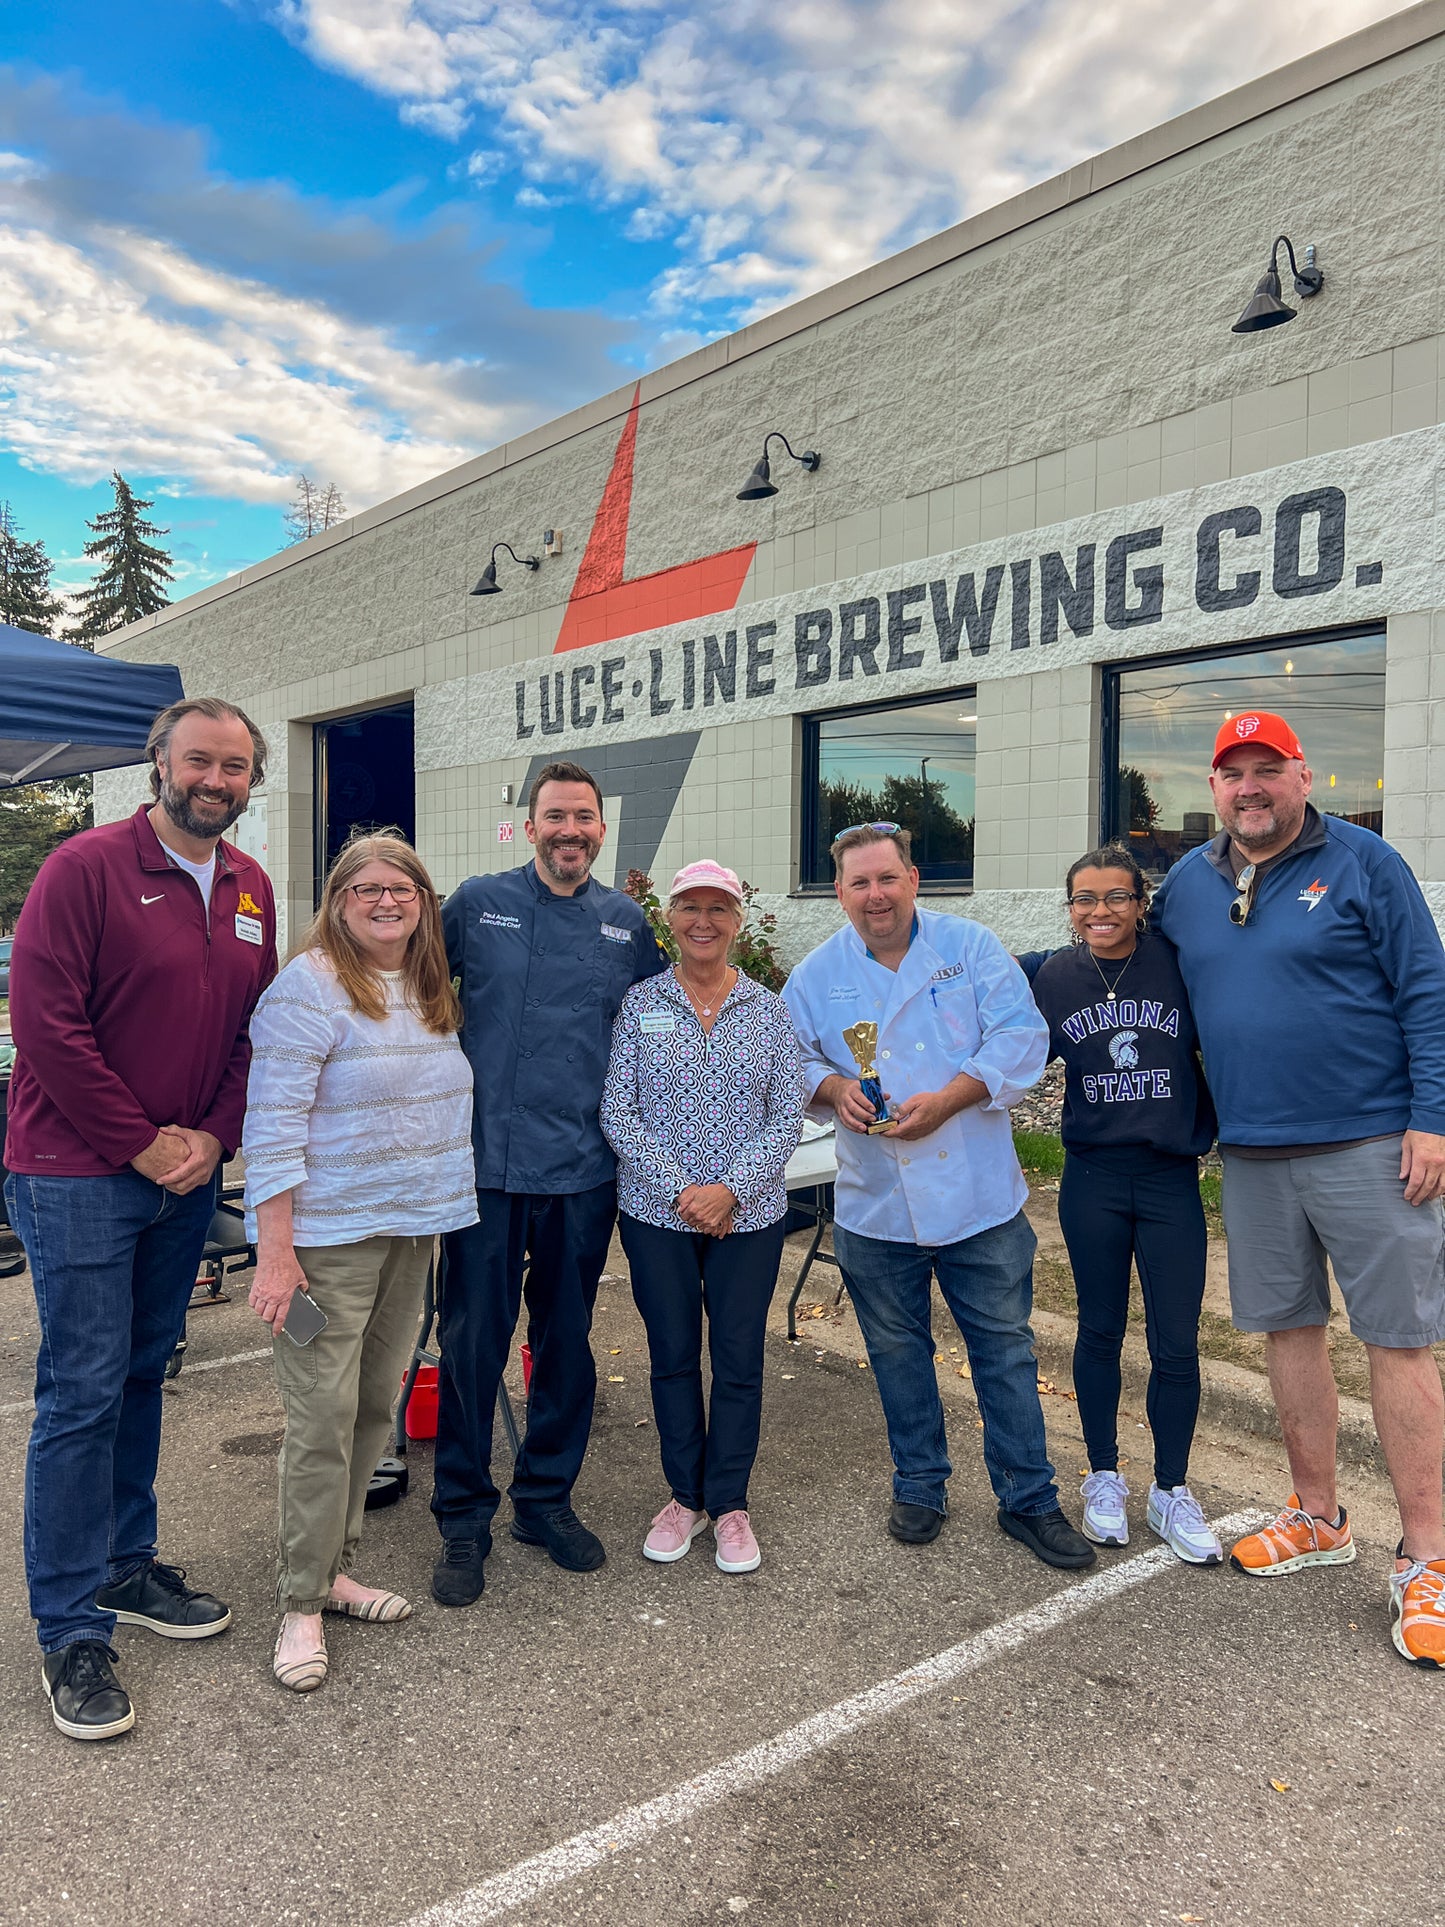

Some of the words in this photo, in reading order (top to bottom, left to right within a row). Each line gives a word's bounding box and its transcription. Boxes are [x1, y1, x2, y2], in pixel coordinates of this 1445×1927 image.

[794, 525, 1164, 690] BREWING
[1195, 486, 1384, 613] CO.
[498, 823, 513, 841] FDC
[237, 892, 263, 914] M
[480, 917, 507, 927] Executive
[507, 921, 521, 929] Chef
[483, 911, 496, 919] Paul
[496, 914, 519, 923] Angeles
[602, 924, 630, 941] BLVD
[932, 963, 963, 980] BLVD
[1061, 999, 1179, 1044] WINONA
[1083, 1069, 1171, 1103] STATE
